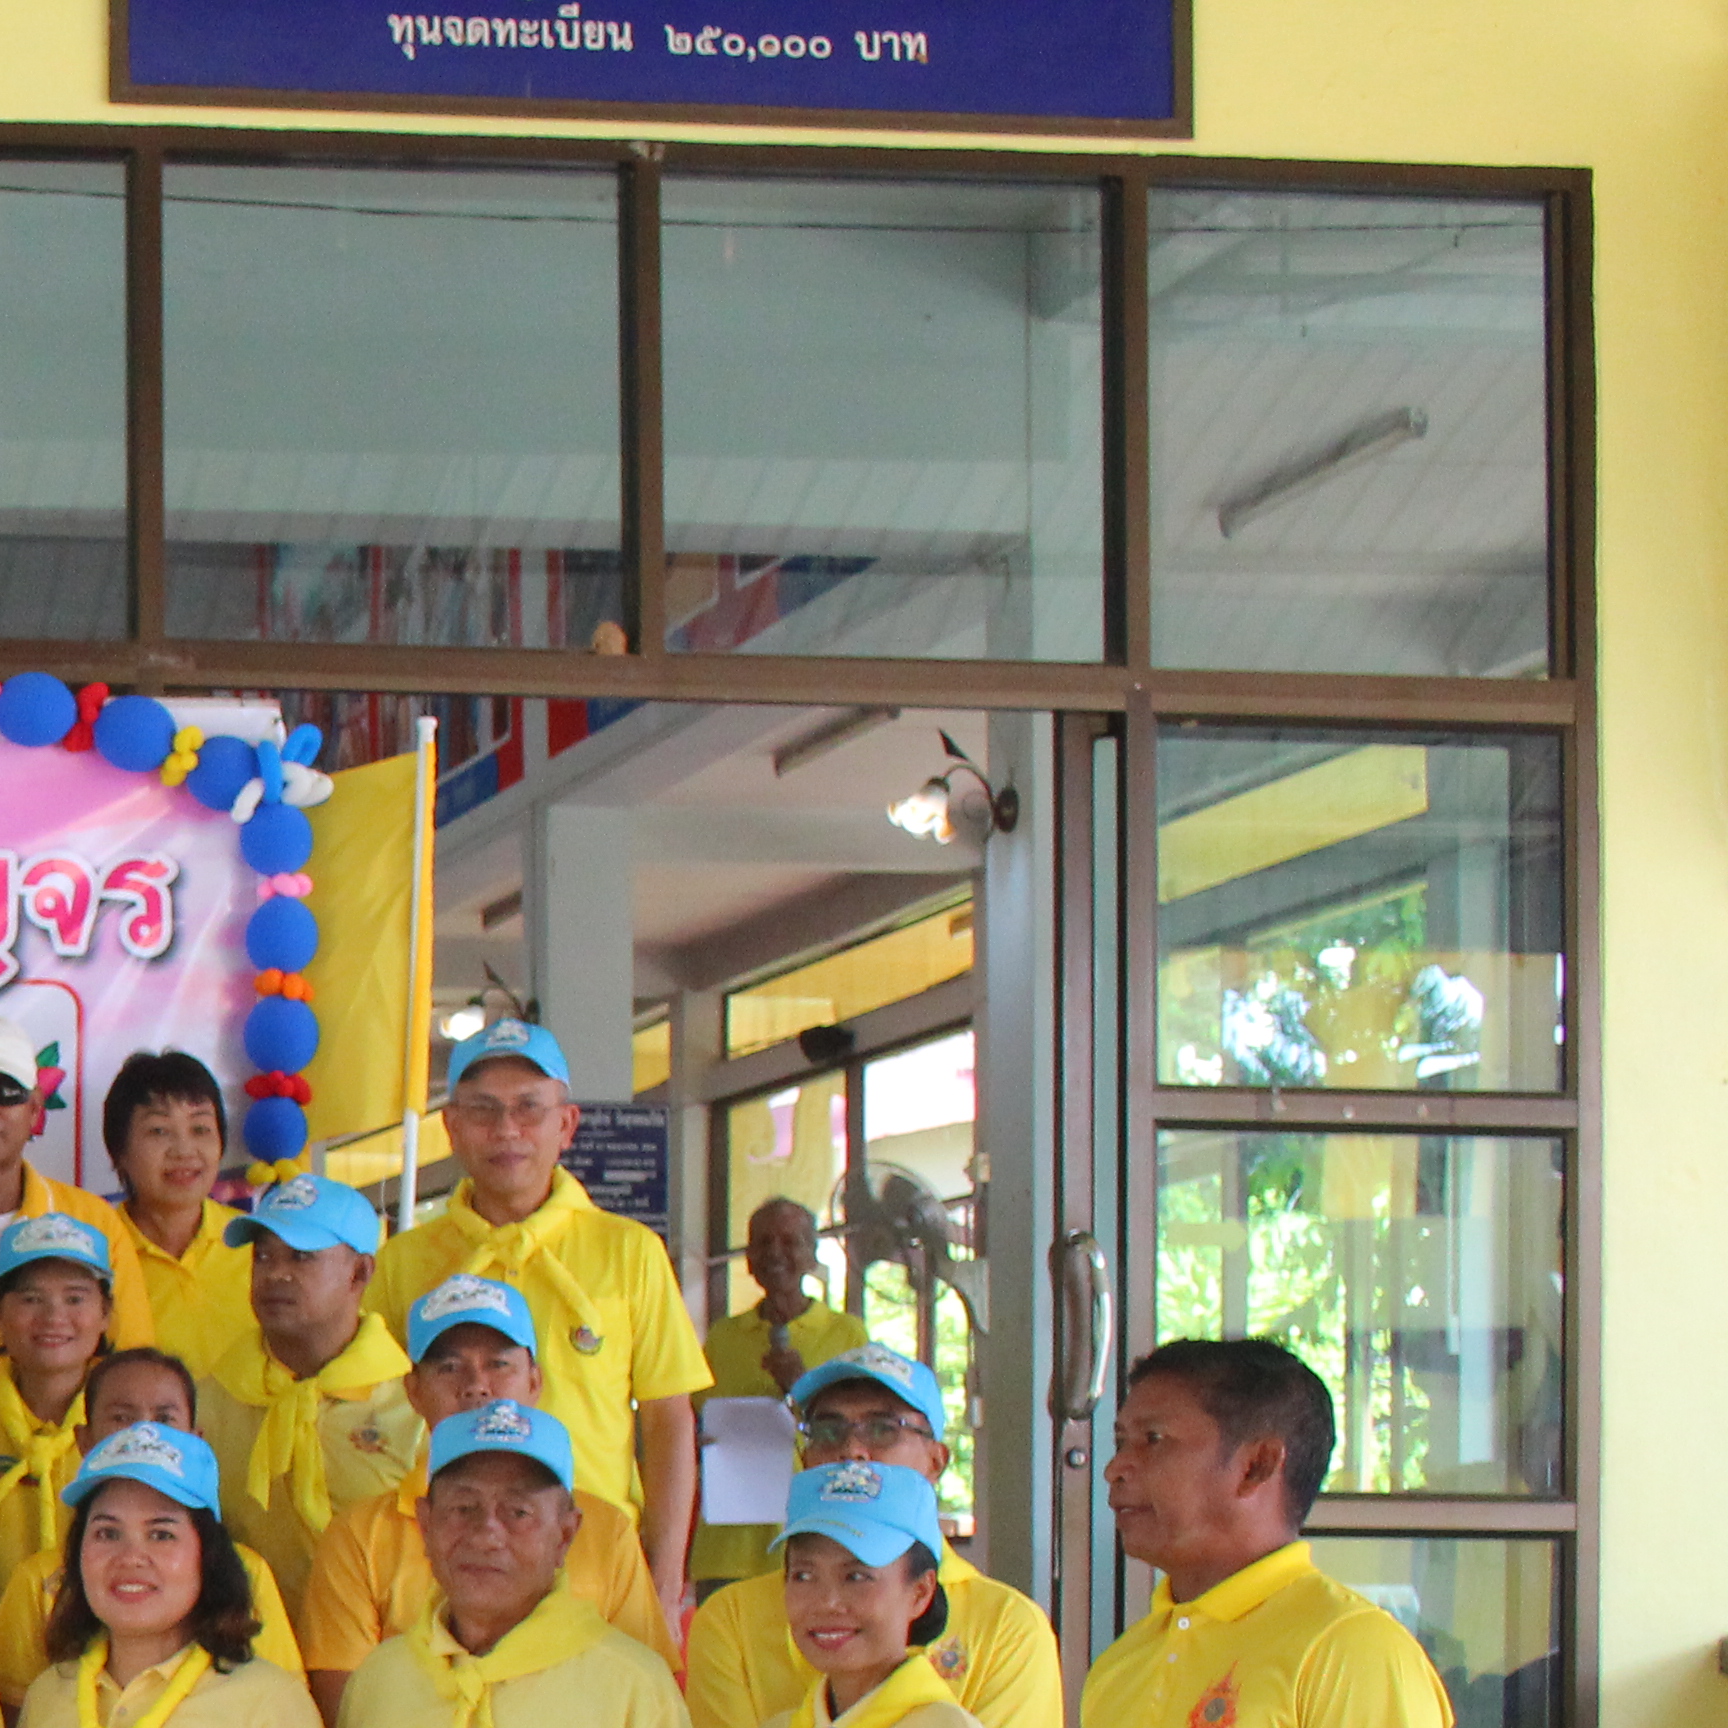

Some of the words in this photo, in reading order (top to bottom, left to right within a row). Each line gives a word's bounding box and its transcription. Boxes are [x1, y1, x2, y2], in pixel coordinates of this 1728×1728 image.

[386, 2, 635, 61] ทุนจดทะเบียน
[663, 23, 833, 63] ๒๕๐,๐๐๐
[853, 30, 928, 64] บาท
